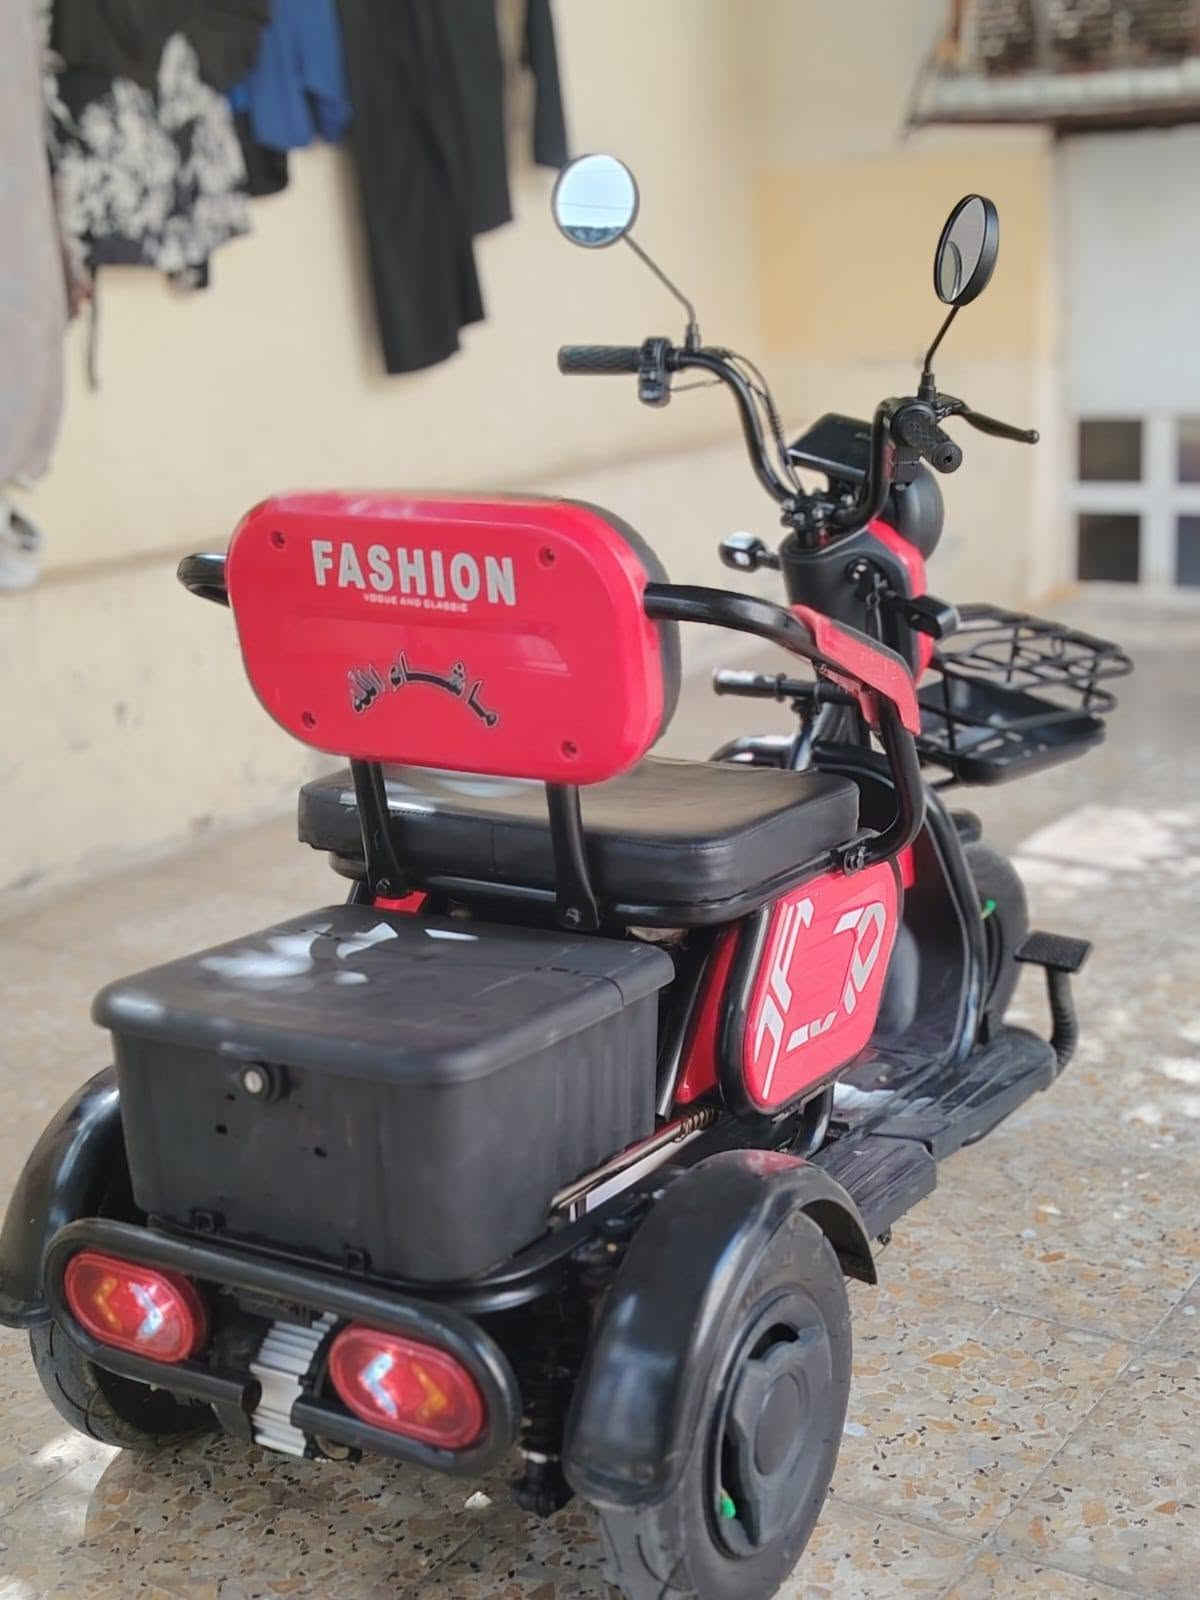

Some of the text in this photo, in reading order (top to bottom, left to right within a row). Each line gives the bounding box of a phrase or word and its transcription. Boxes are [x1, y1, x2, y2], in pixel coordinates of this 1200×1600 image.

[311, 539, 517, 606] FASHION
[400, 597, 422, 609] AND
[347, 664, 386, 713] الله
